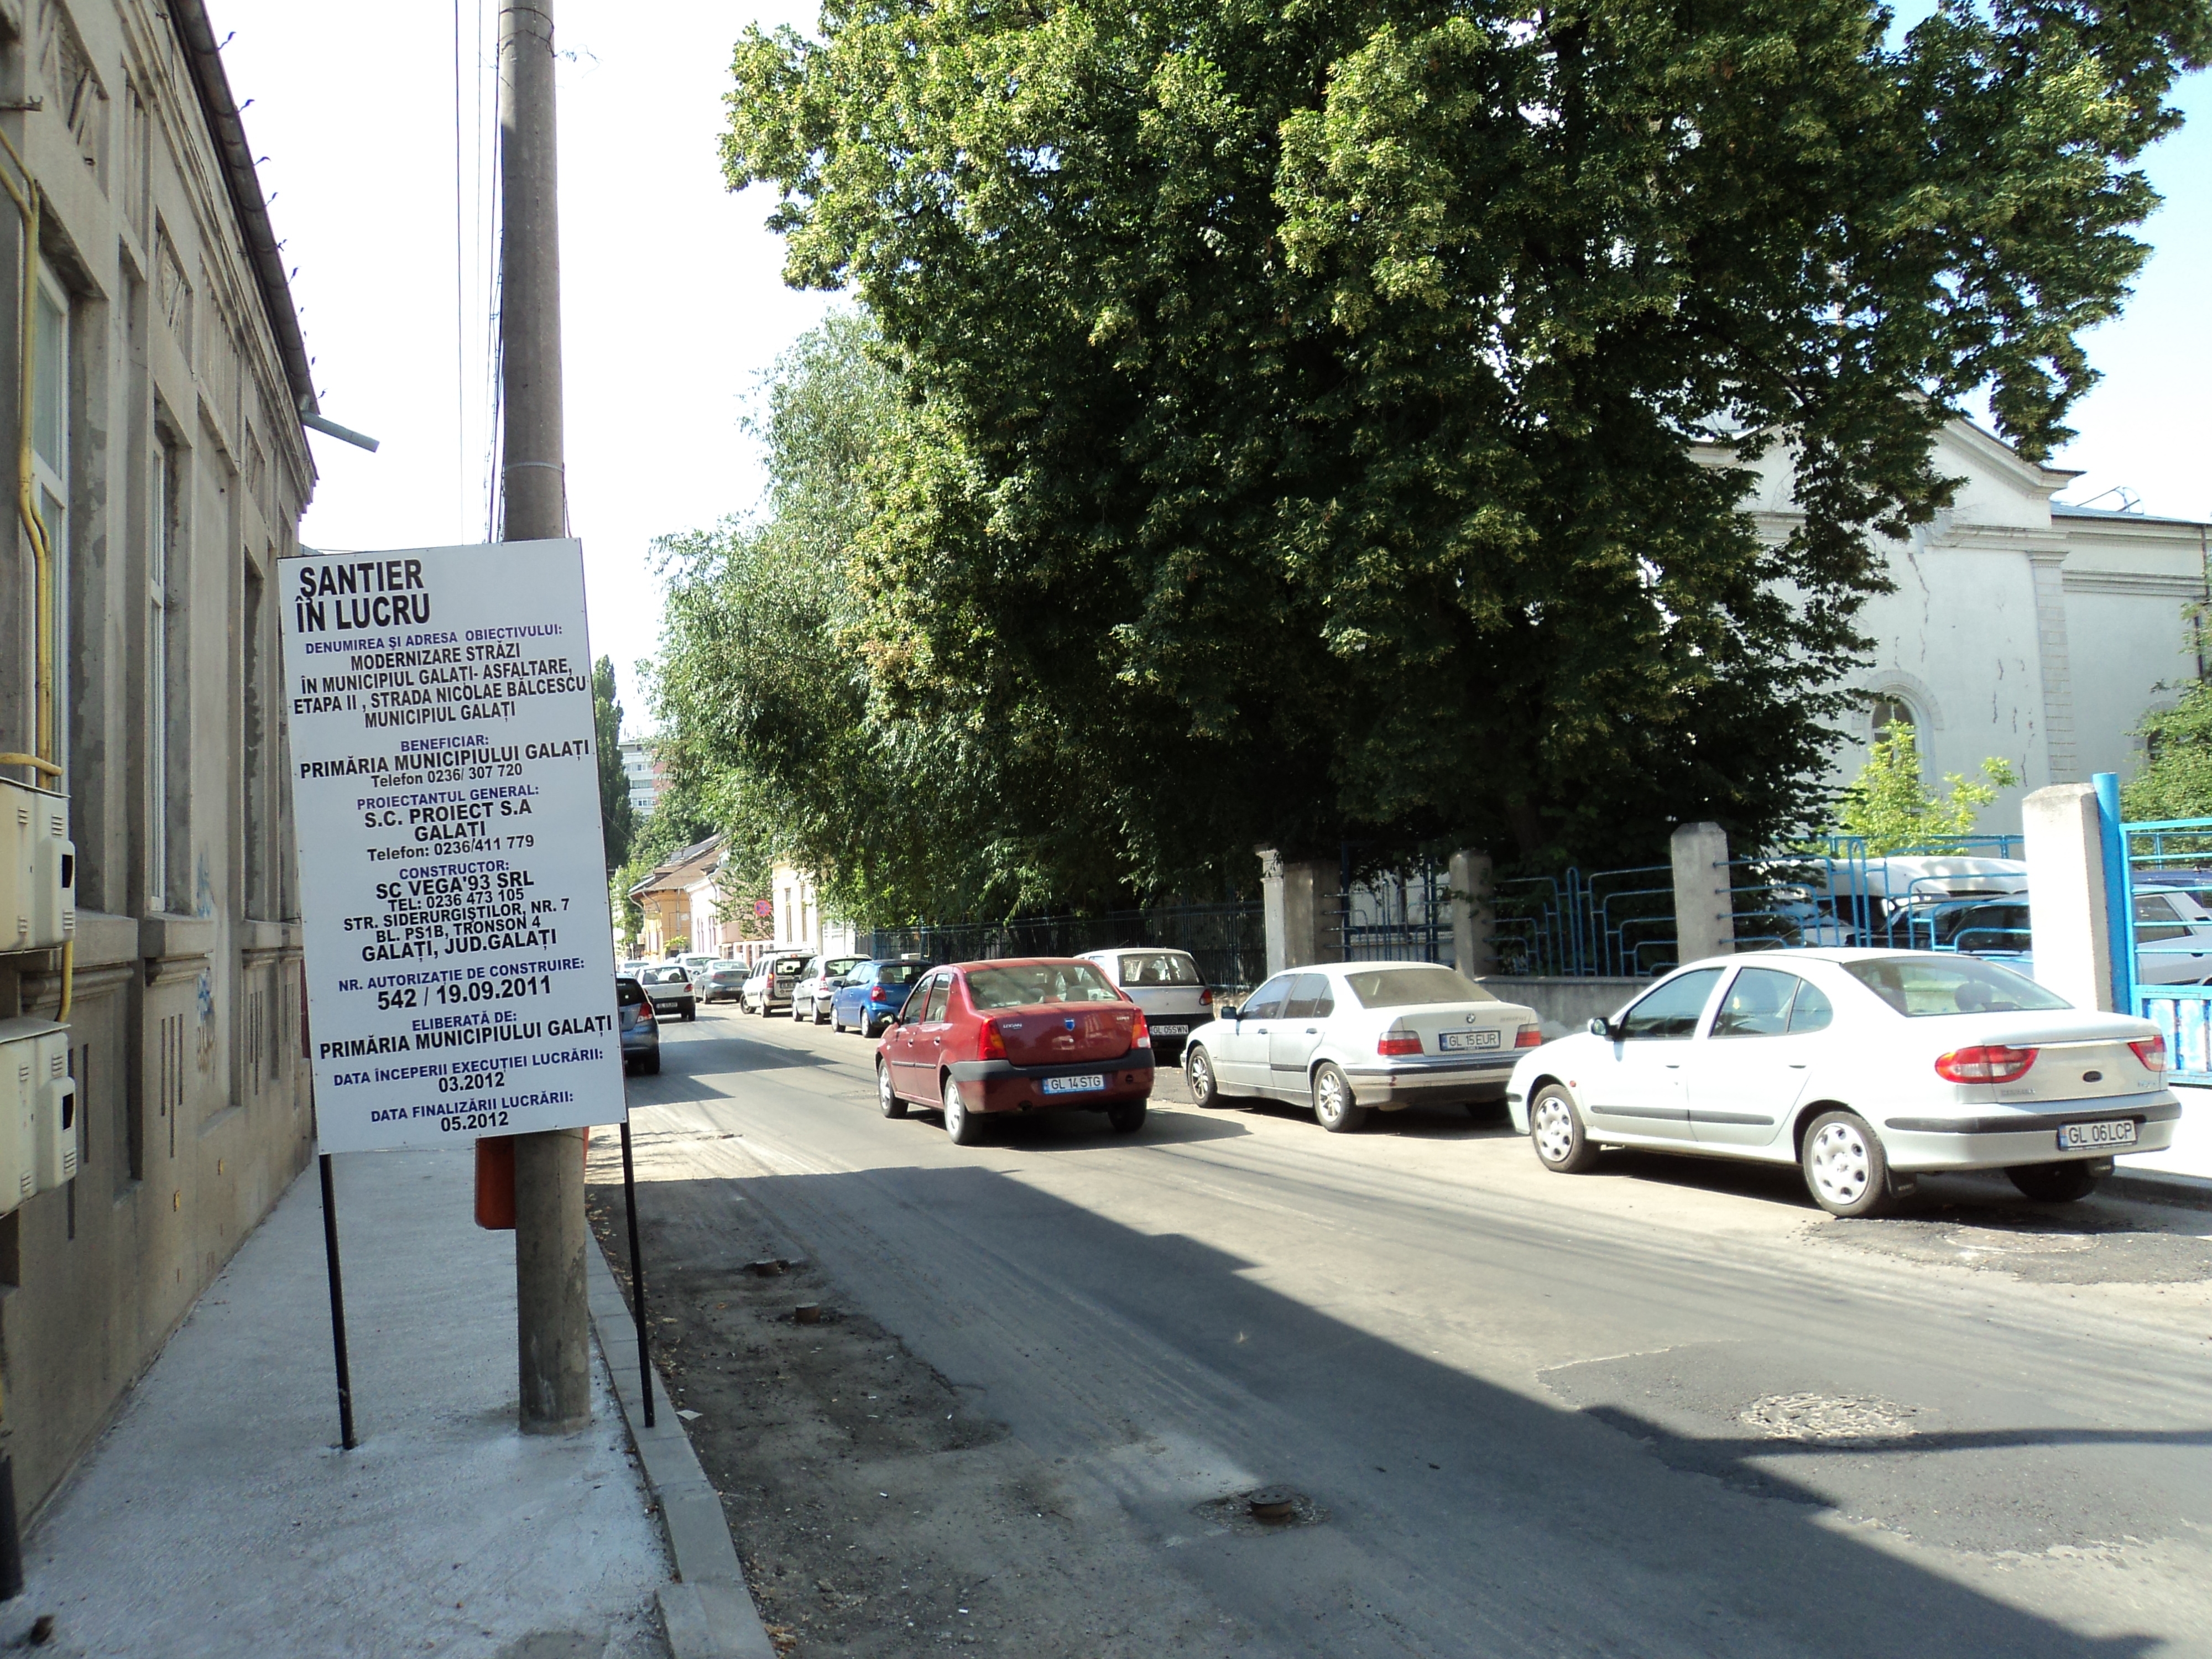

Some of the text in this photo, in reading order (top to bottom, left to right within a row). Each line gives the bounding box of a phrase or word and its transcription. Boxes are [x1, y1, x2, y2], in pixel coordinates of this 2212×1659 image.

[295, 594, 430, 633] ÎN LUCRU
[305, 638, 385, 654] DENUMIREA
[405, 632, 458, 647] ADRESA
[465, 624, 562, 642] OBIECTIVULUI:
[351, 640, 520, 671] MODERNIZARE STRĂZI
[301, 675, 317, 694] ÎN
[322, 671, 414, 692] MUNICIPIUL
[483, 659, 572, 681] ASFALTARE,
[294, 696, 342, 714] ETAPA
[347, 695, 356, 711] II
[371, 688, 432, 708] STRADA
[436, 682, 502, 703] NICOLAE
[507, 676, 586, 697] BĂLCESCU
[365, 706, 456, 728] MUNICIPIUL
[400, 734, 488, 752] BENEFICIAR:
[300, 755, 389, 779] PRIMĂRIA
[394, 745, 519, 771] MUNICIPIULUI
[371, 763, 522, 788] Telefon 0236/ 307 720
[357, 784, 539, 811] PROIECTANTUL GENERAL:
[364, 799, 532, 828] S.C. PROIECT S.A
[367, 834, 534, 862] Telefon: 0236/411 779
[399, 860, 509, 880] CONSTRUCTOR:
[376, 870, 534, 900] SC VEGA'93 SRL
[387, 888, 524, 912] TEL: 0236 473 105
[343, 916, 378, 932] STR.
[531, 900, 557, 914] NR.
[561, 898, 570, 911] 7
[375, 915, 541, 943] BL. PS1B, TRONSON 4
[338, 979, 363, 993] NR.
[467, 967, 485, 980] DE
[489, 957, 584, 978] CONSTRUIRE:
[378, 988, 417, 1011] 542
[436, 975, 550, 1005] 19.09.2011
[411, 1010, 517, 1032] ELIBERATĂ DE:
[319, 1034, 410, 1060] PRIMĂRIA
[415, 1021, 541, 1050] MUNICIPIULUI
[1449, 1036, 1462, 1046] GL
[333, 1072, 371, 1087] DATA
[374, 1063, 447, 1082] ÎNCEPERII
[532, 1047, 603, 1066] LUCRĂRII:
[439, 1071, 505, 1093] 03.2012
[1051, 1079, 1066, 1089] GL
[371, 1090, 573, 1123] DATA FINALIZĂRII LUCRĂRII:
[440, 1111, 509, 1133] 05.2012
[2069, 1126, 2087, 1144] GL
